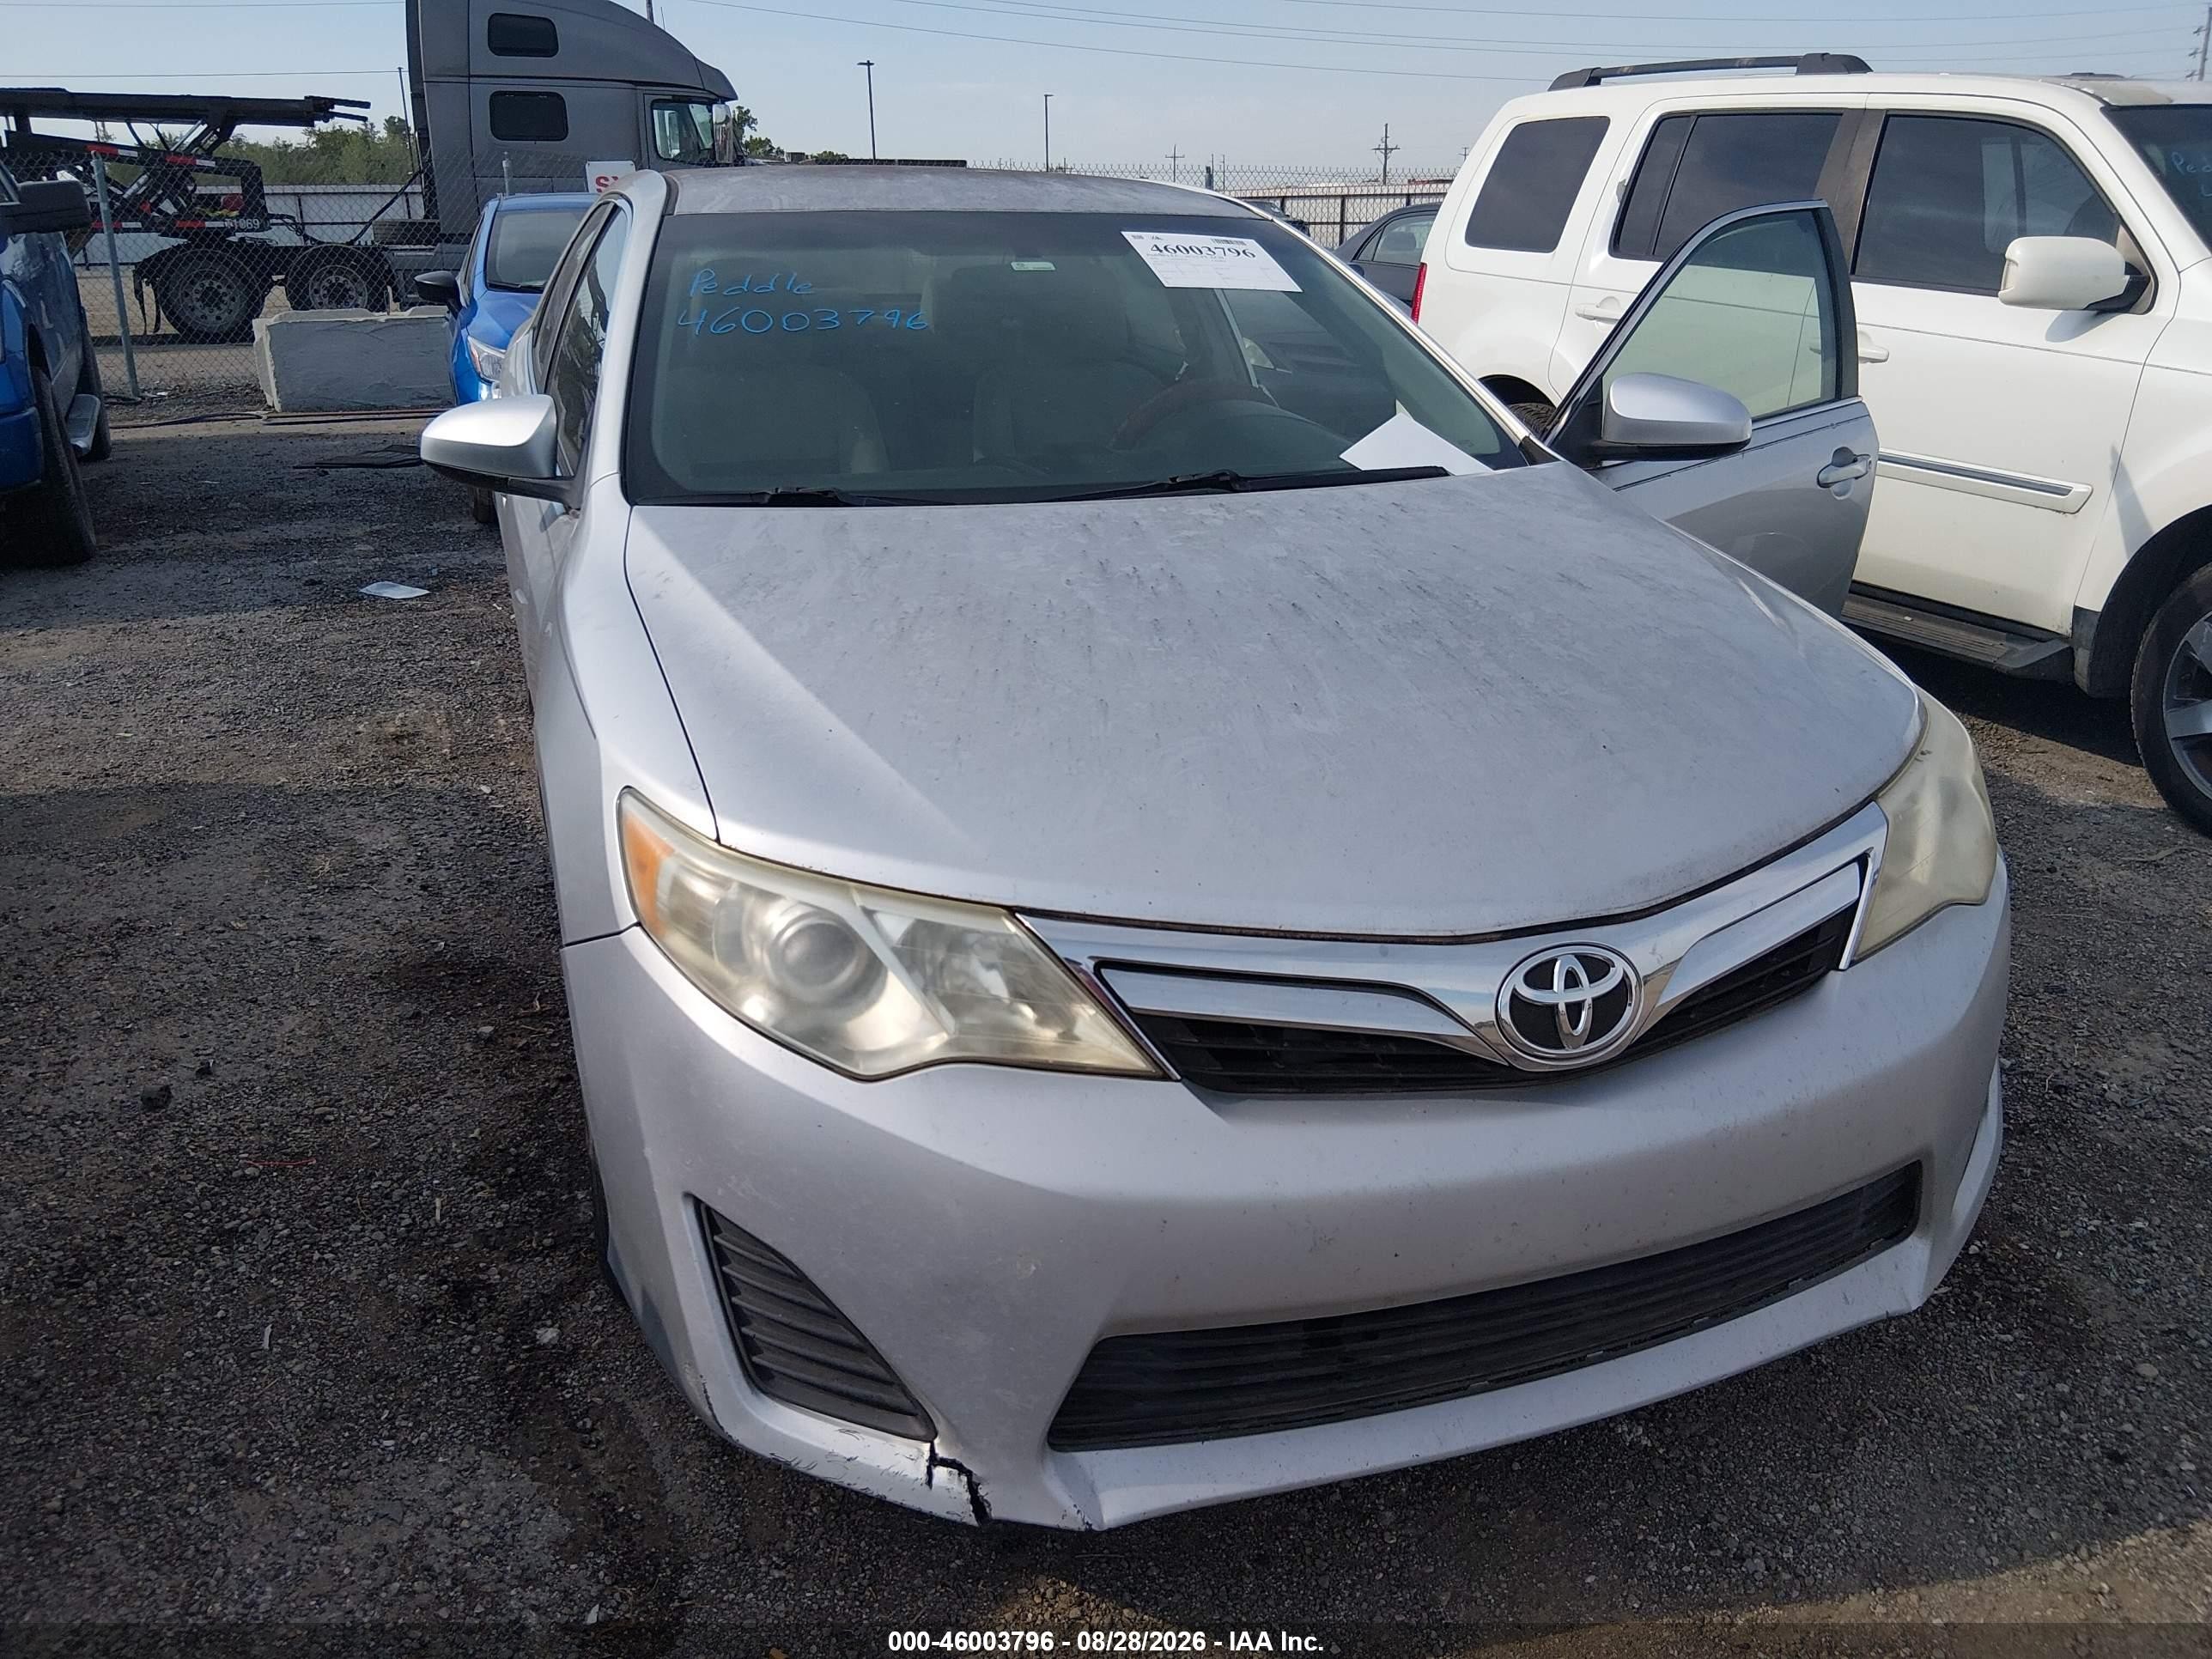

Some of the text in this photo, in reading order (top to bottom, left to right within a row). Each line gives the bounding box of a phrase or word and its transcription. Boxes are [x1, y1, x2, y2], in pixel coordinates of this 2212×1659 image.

[1150, 243, 1256, 259] 46003796
[690, 268, 814, 297] Peddle
[678, 307, 929, 335] 46003796
